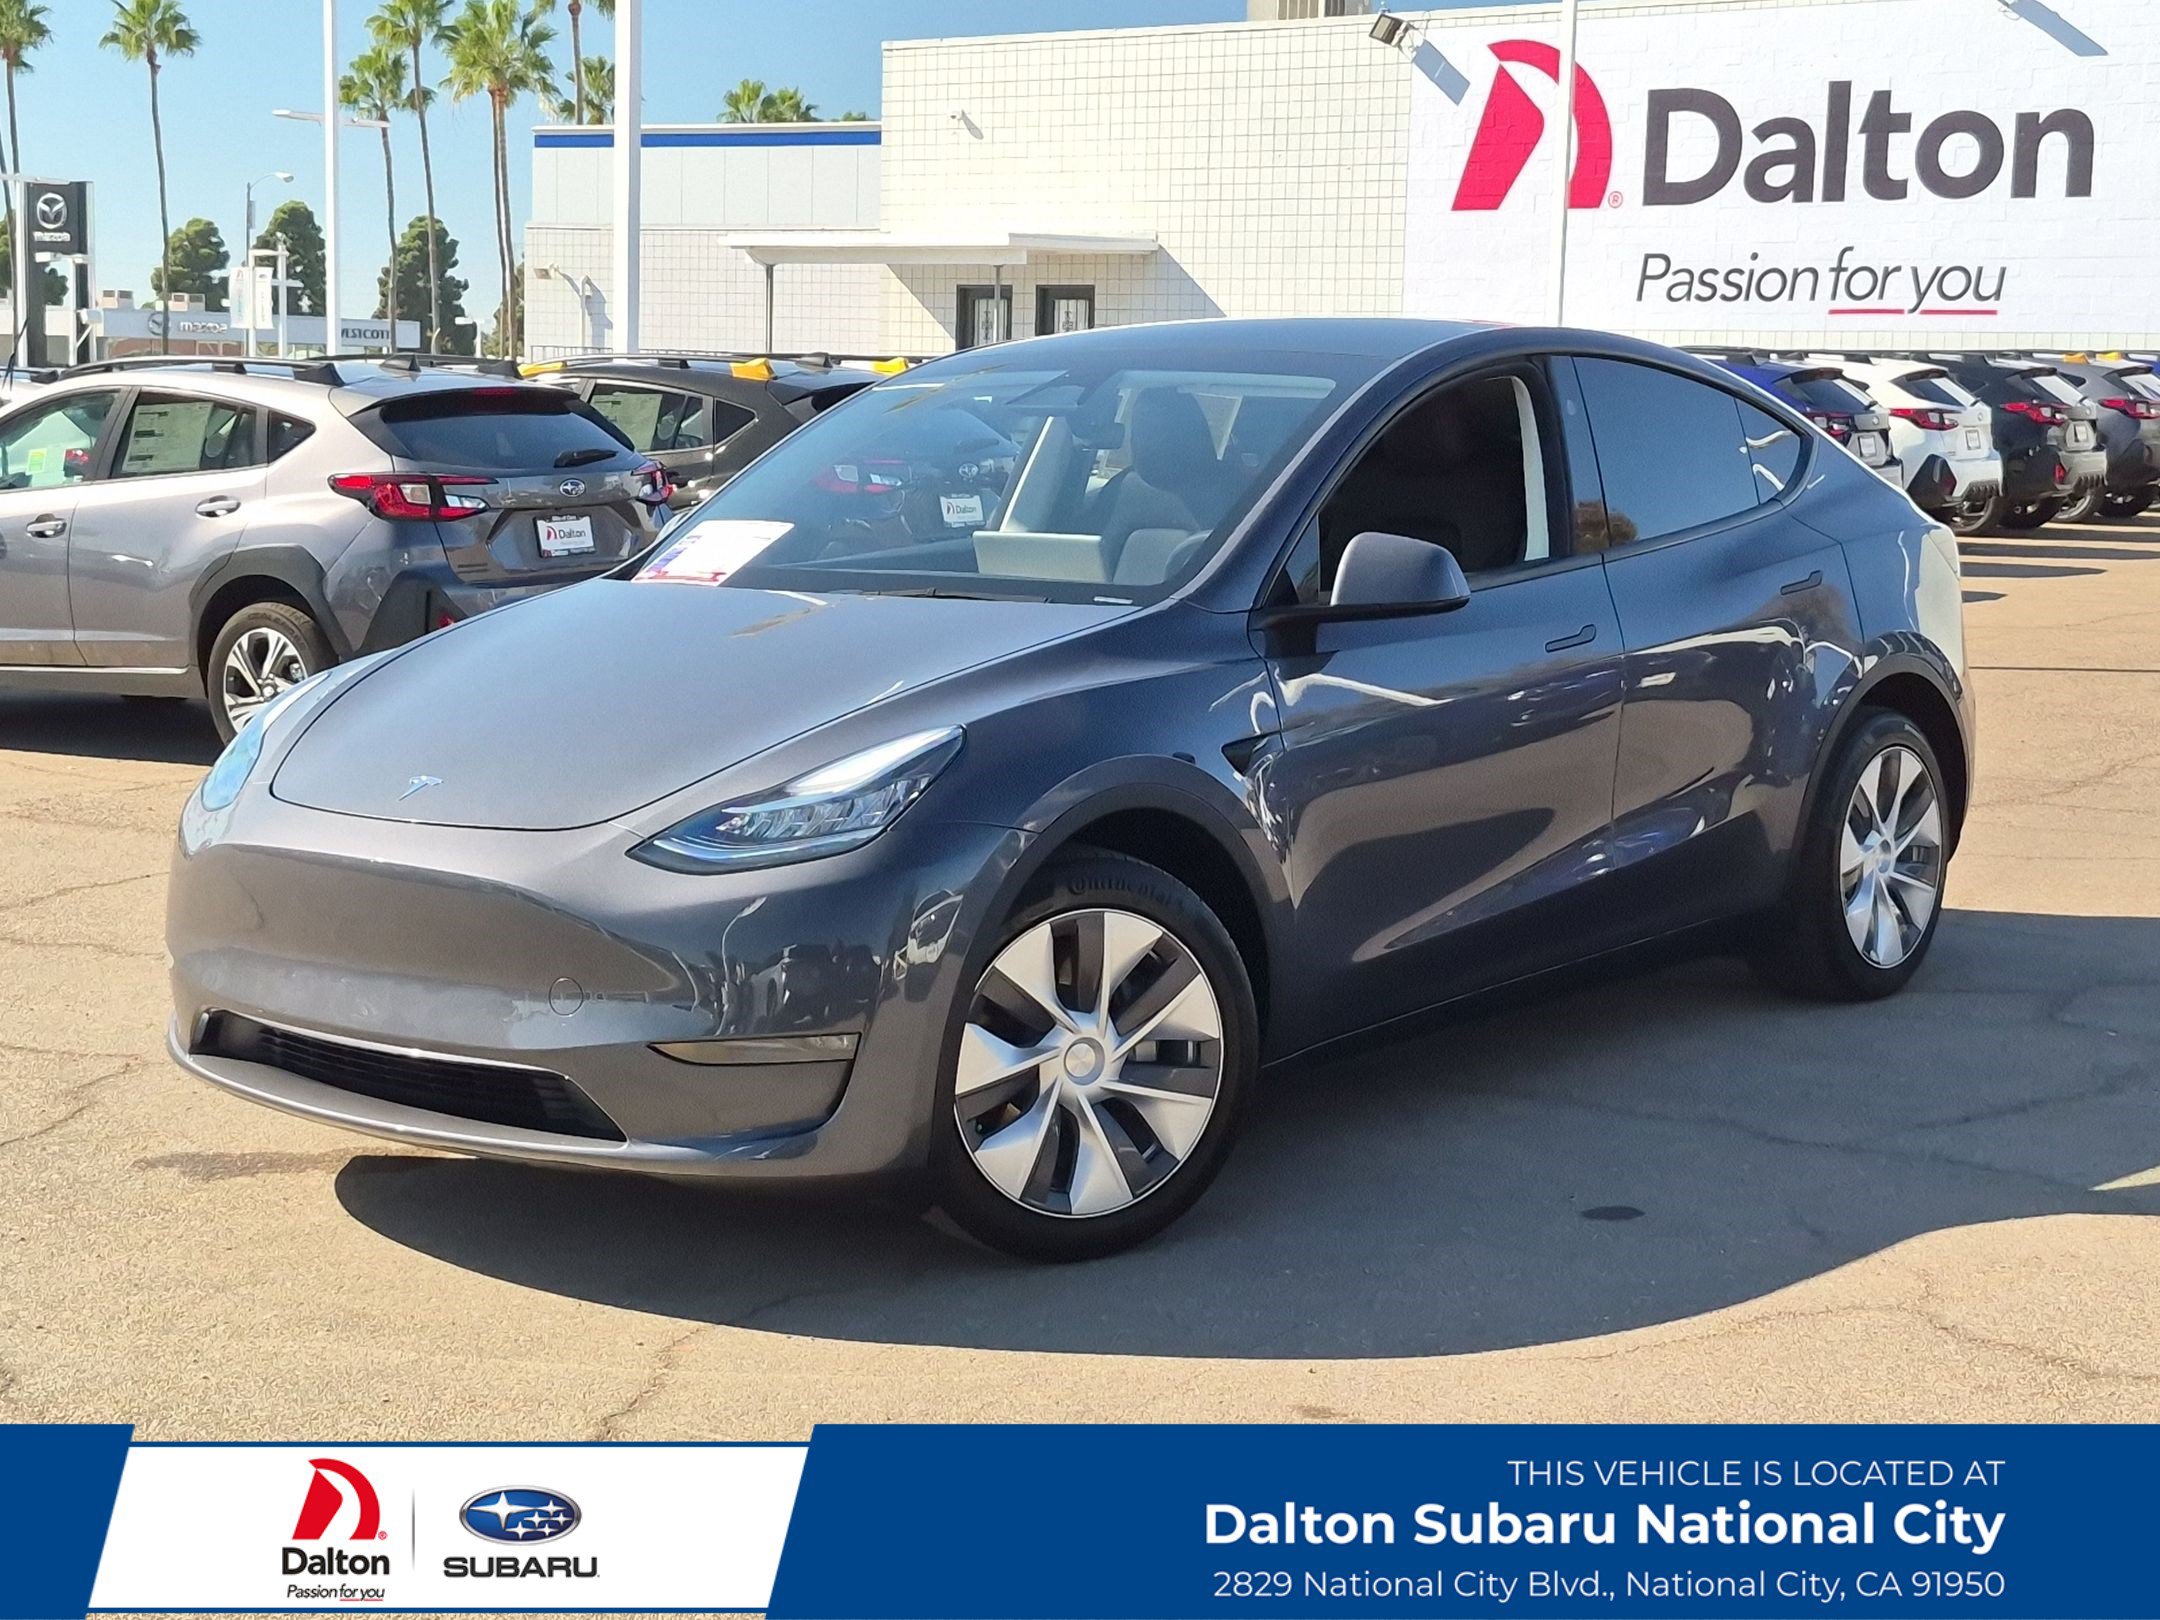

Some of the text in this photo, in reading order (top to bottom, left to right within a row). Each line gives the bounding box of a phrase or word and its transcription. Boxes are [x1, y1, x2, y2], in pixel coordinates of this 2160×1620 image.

[1643, 80, 2095, 207] Dalton
[1636, 246, 2007, 315] Passion for you
[558, 528, 587, 539] Dalton
